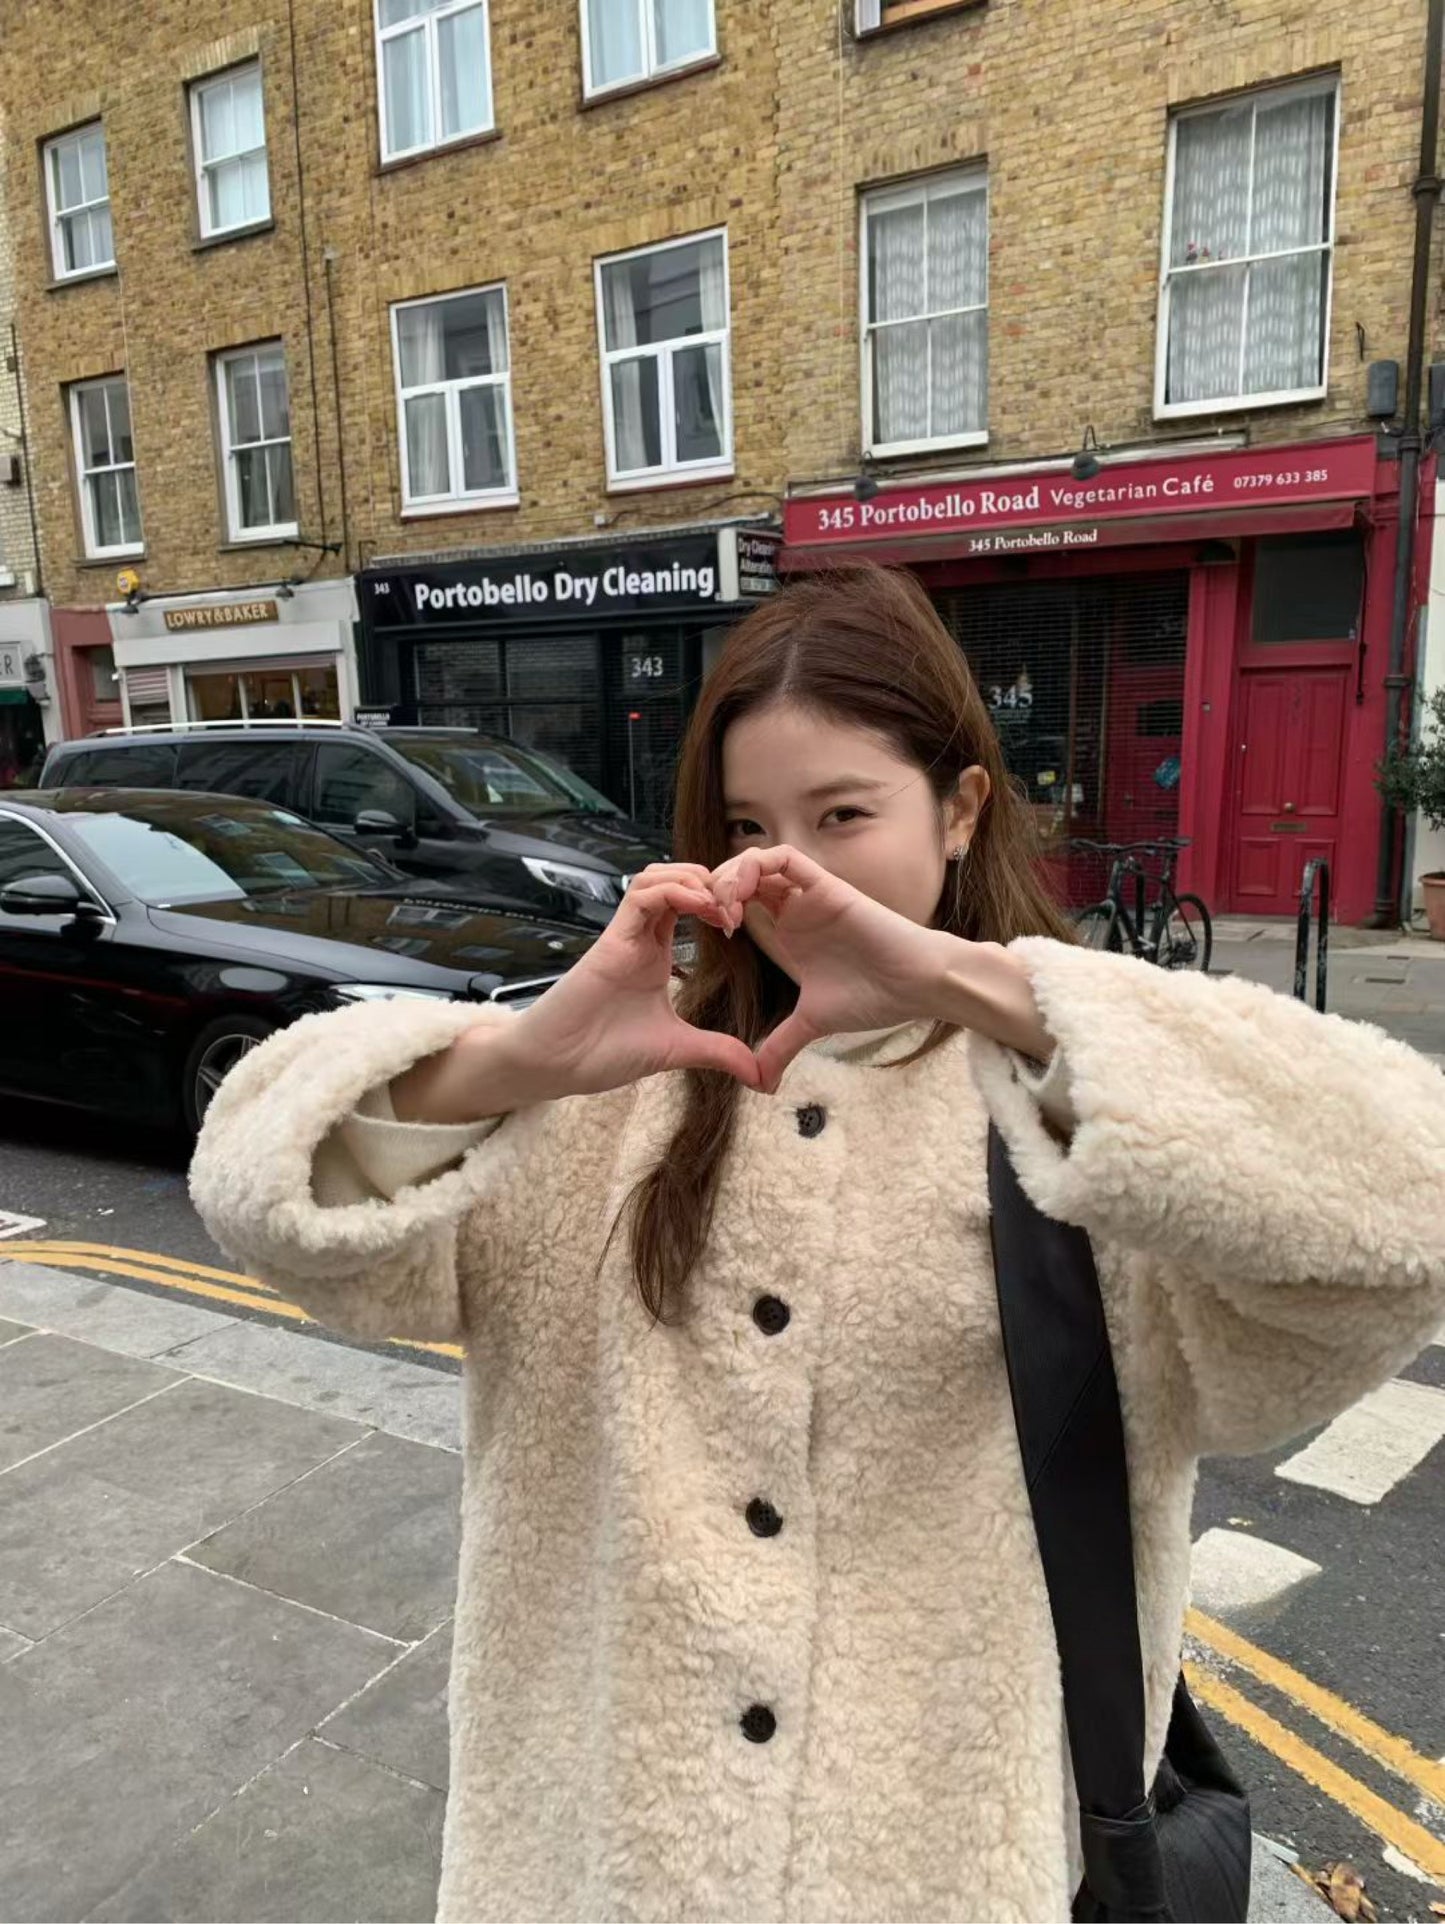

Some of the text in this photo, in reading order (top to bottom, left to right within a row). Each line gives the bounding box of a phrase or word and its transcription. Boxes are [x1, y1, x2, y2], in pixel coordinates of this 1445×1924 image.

[818, 469, 1328, 530] 345 Portobello Road Vegetarian Café 07379 633 385
[969, 528, 1098, 552] 345 Portobello Road
[374, 582, 390, 595] 343
[414, 574, 548, 610] Portobello
[554, 572, 599, 606] Dry
[602, 561, 714, 598] Cleaning
[166, 603, 269, 628] LOWRY&BAKER
[631, 656, 664, 678] 343
[987, 684, 1033, 709] 345
